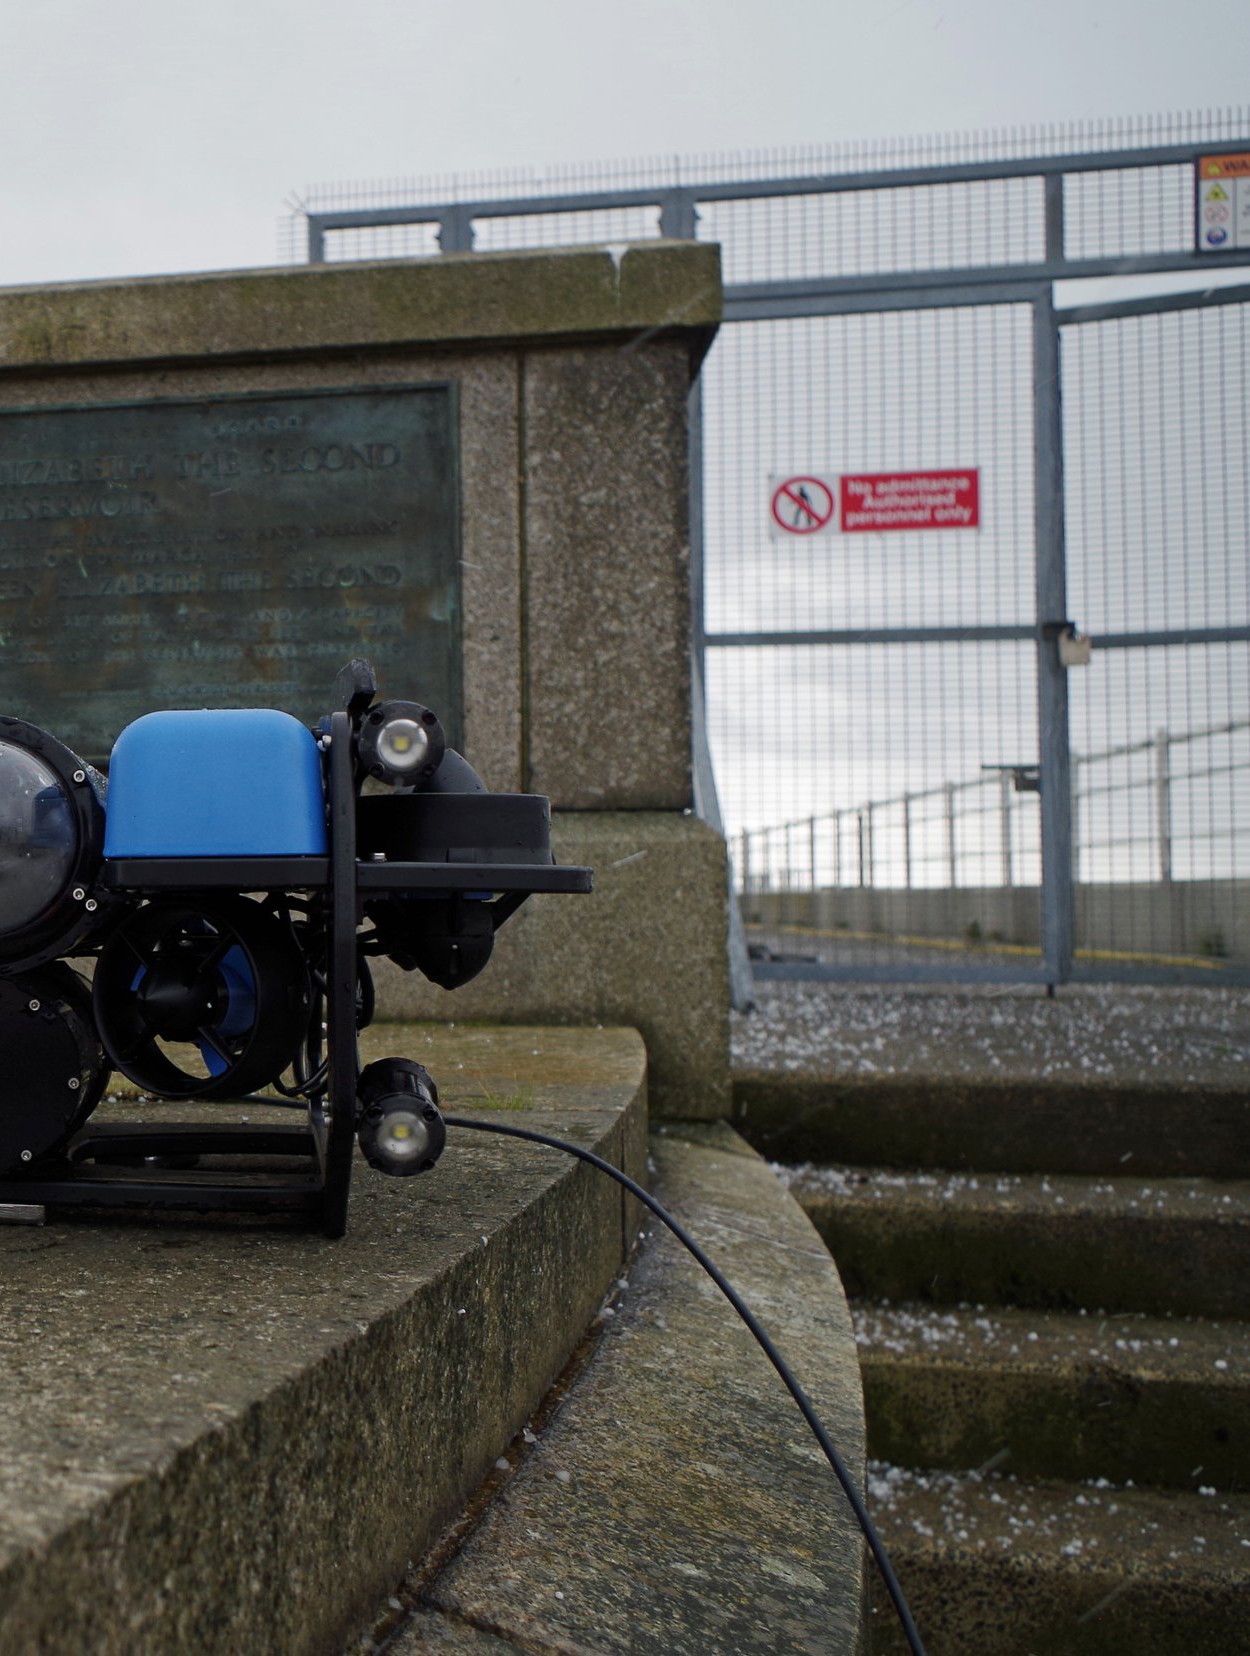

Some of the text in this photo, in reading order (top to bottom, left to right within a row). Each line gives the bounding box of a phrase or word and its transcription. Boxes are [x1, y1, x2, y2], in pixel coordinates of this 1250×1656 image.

[172, 450, 240, 479] THE
[261, 442, 401, 474] SECOND
[933, 504, 973, 524] only
[58, 571, 205, 598] ELIZABETH
[285, 563, 402, 589] SECOND
